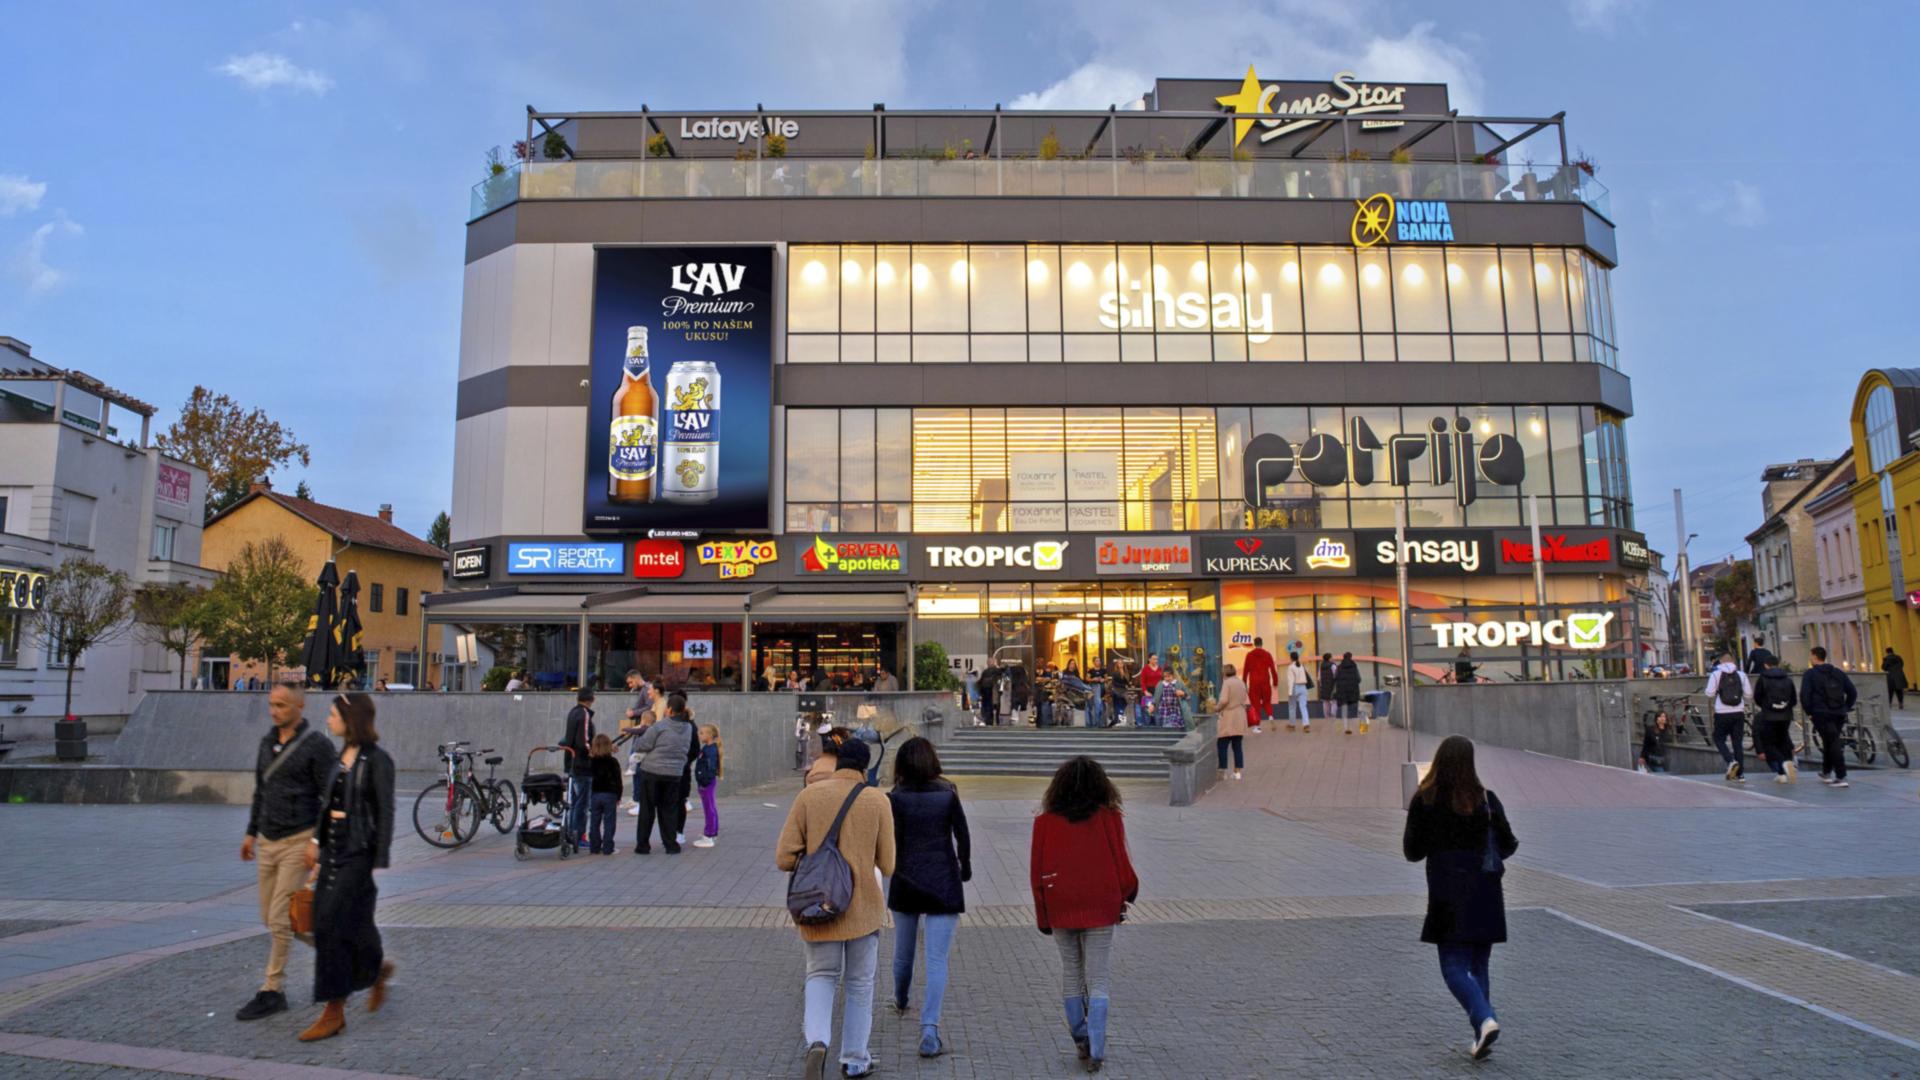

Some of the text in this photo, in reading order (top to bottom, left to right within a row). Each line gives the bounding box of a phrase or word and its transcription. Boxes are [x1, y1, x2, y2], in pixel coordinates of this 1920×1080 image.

[1257, 72, 1406, 128] CineStar
[1396, 201, 1450, 222] NOVA
[1398, 223, 1454, 241] BANKA
[671, 262, 747, 296] LAV
[661, 295, 755, 317] Premium
[1098, 279, 1274, 343] sinsay
[663, 318, 753, 330] 100% PO NAŠEM
[685, 331, 729, 341] UKUSU!
[673, 411, 710, 430] LAV
[558, 548, 606, 558] SPORT
[703, 545, 773, 560] DEXY CO
[837, 543, 900, 557] CRVENA
[926, 546, 1031, 567] TROPIC
[1315, 540, 1344, 557] dm
[558, 558, 616, 568] REALITY
[639, 551, 681, 566] m:tel
[838, 556, 901, 574] apoteka
[1141, 563, 1171, 571] SPORT
[1206, 555, 1293, 573] KUPREŠAK
[722, 562, 753, 577] kids
[1232, 631, 1252, 643] dm
[1431, 620, 1567, 648] TROPIC
